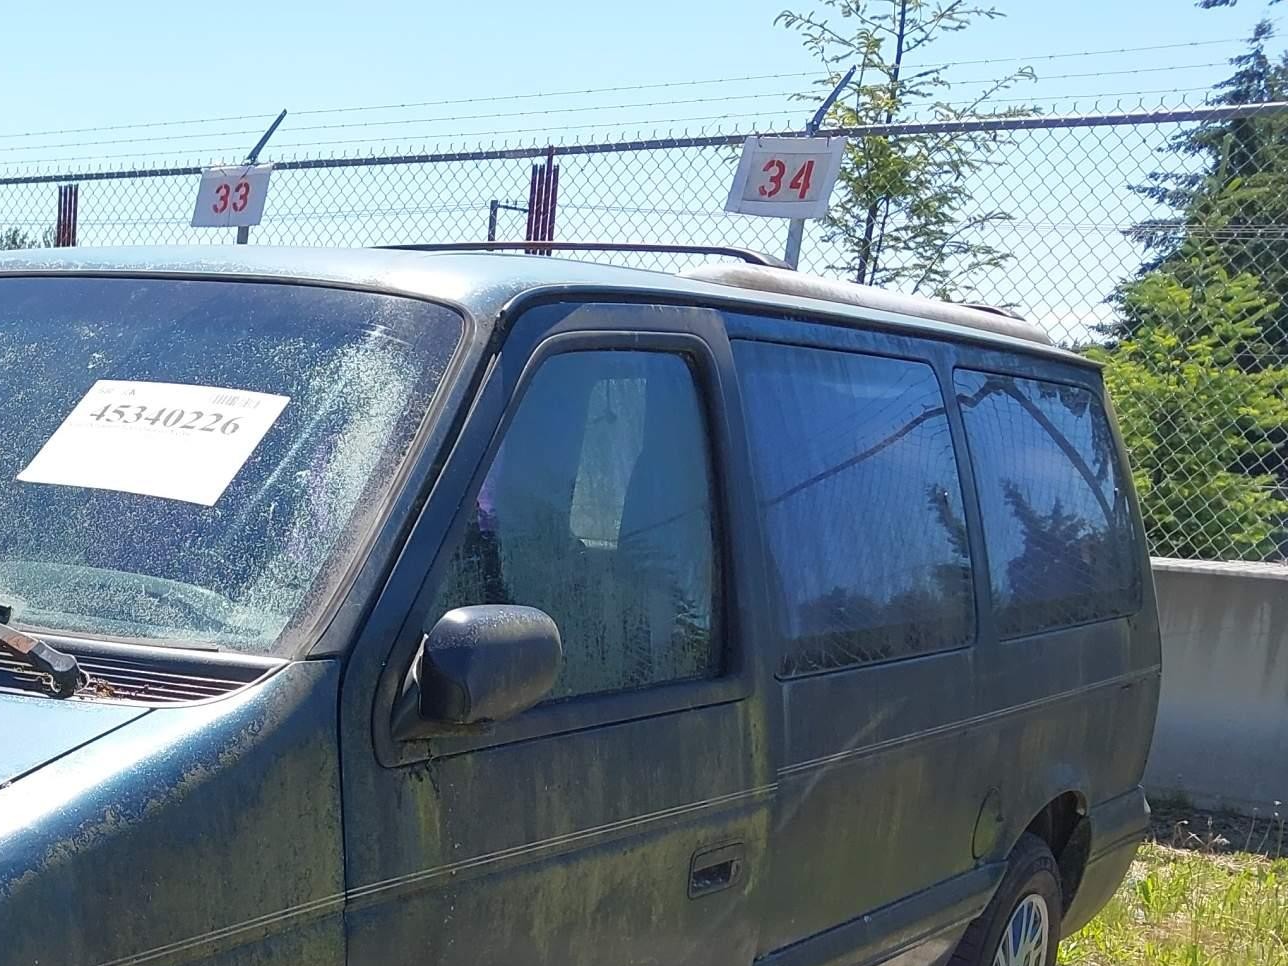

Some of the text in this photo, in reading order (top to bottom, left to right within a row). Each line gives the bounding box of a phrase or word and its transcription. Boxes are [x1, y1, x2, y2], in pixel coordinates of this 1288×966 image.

[758, 159, 815, 199] 34
[212, 182, 250, 214] 33
[90, 403, 243, 435] 45340226
